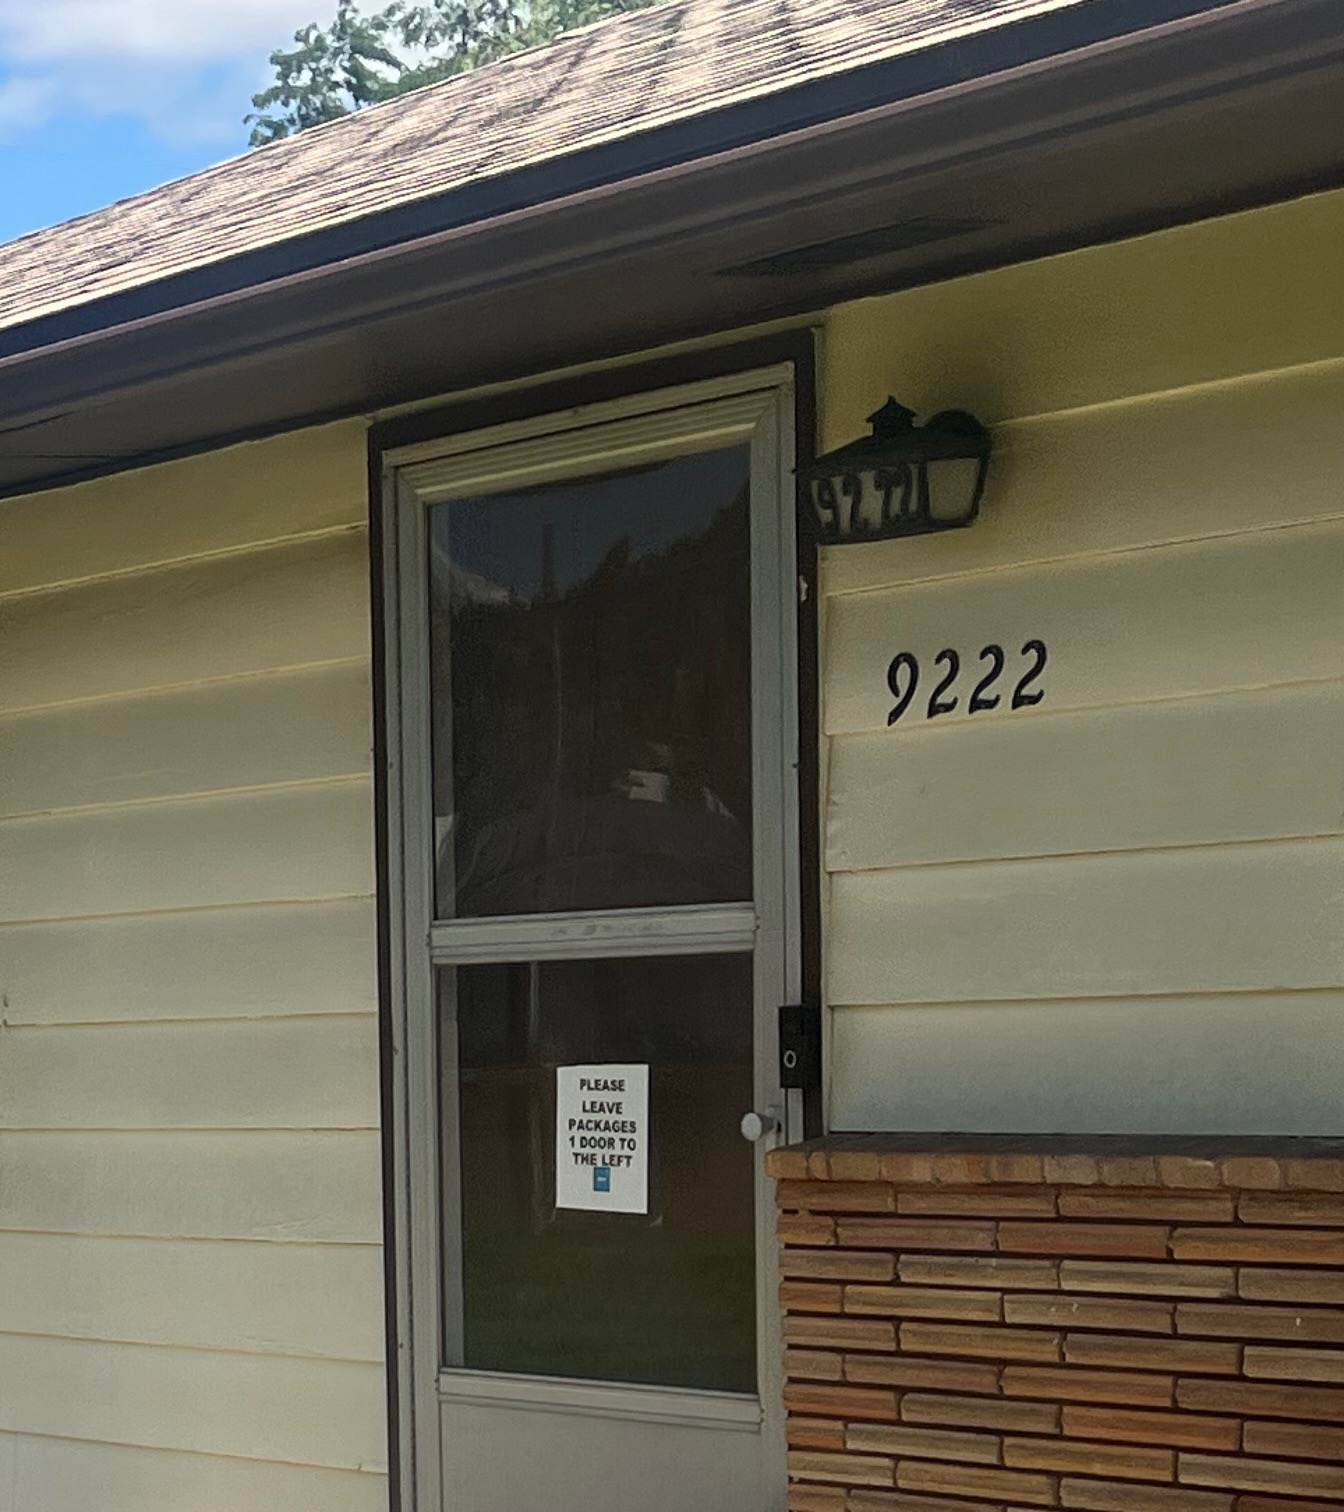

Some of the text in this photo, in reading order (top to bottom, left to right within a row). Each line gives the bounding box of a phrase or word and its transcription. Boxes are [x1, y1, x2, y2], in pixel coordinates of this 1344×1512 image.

[887, 639, 1048, 727] 9222
[579, 1078, 626, 1092] PLEASE
[582, 1101, 623, 1115] LEAVE
[568, 1118, 637, 1134] PACKAGES
[569, 1135, 637, 1151] 1 DOOR TO
[572, 1152, 633, 1168] THE LEFT
